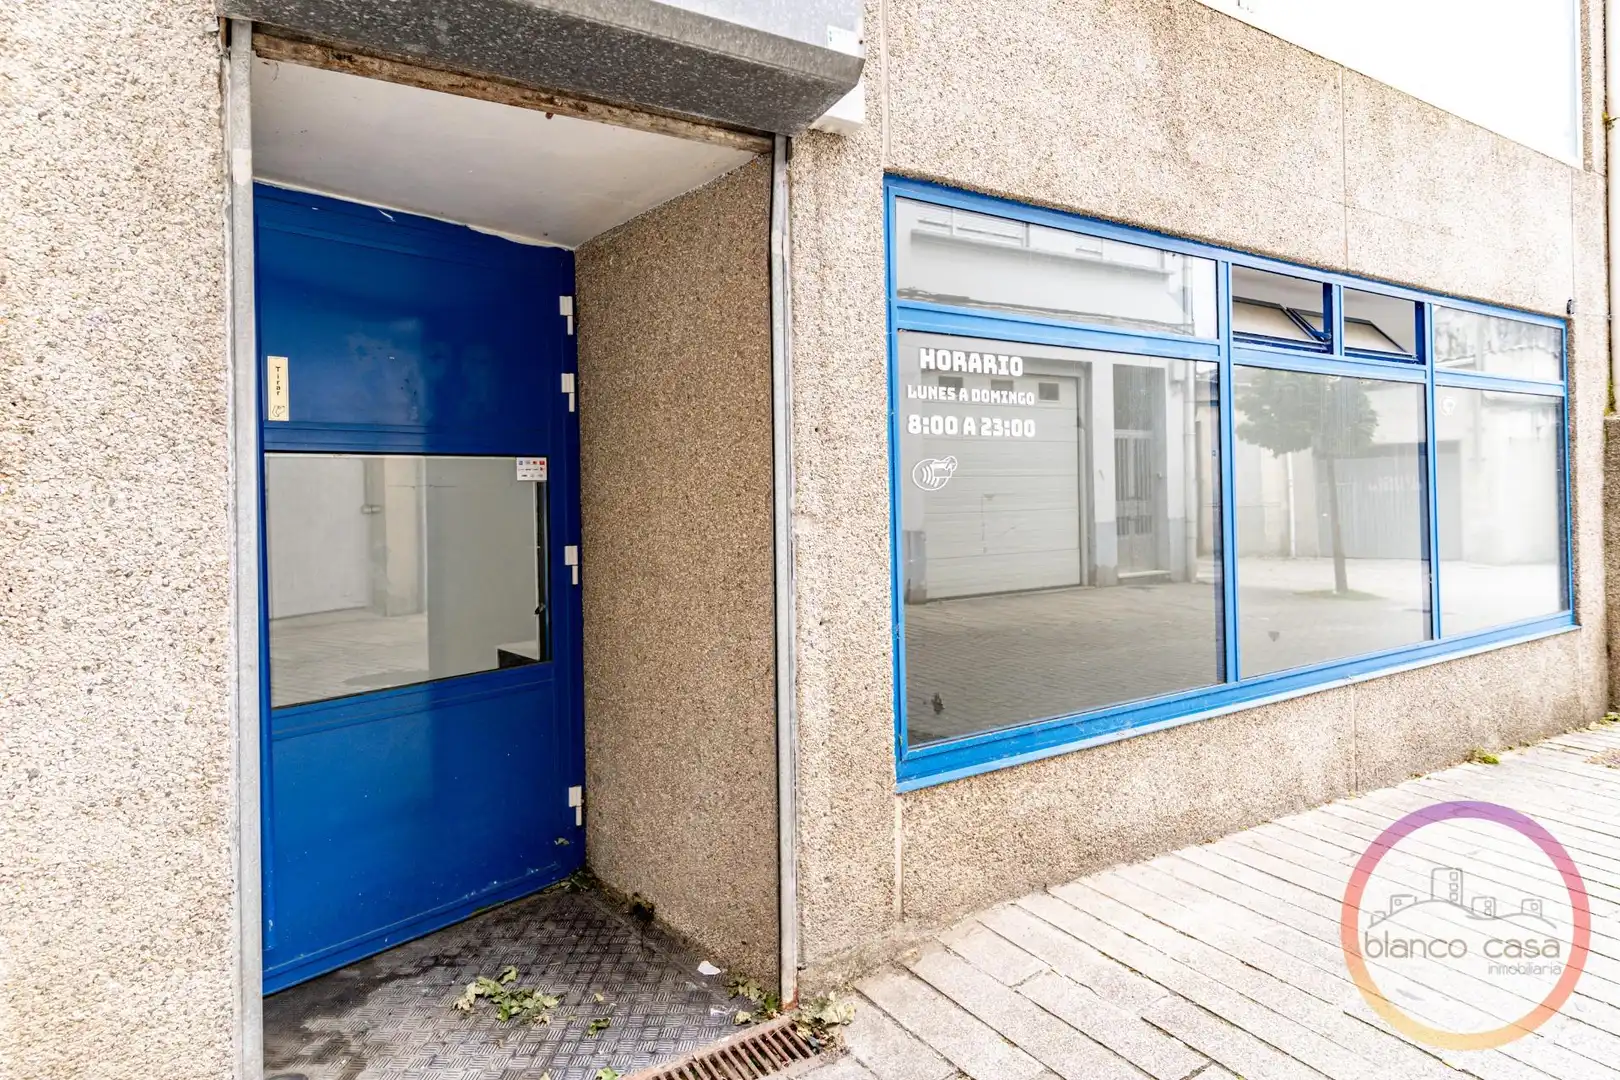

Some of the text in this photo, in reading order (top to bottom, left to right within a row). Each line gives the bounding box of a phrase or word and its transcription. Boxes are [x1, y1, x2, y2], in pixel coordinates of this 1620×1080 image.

[919, 348, 1023, 376] HORARIO
[907, 384, 1035, 405] LUNES A DOMINGO
[907, 414, 1036, 437] 8:00 A 23:00
